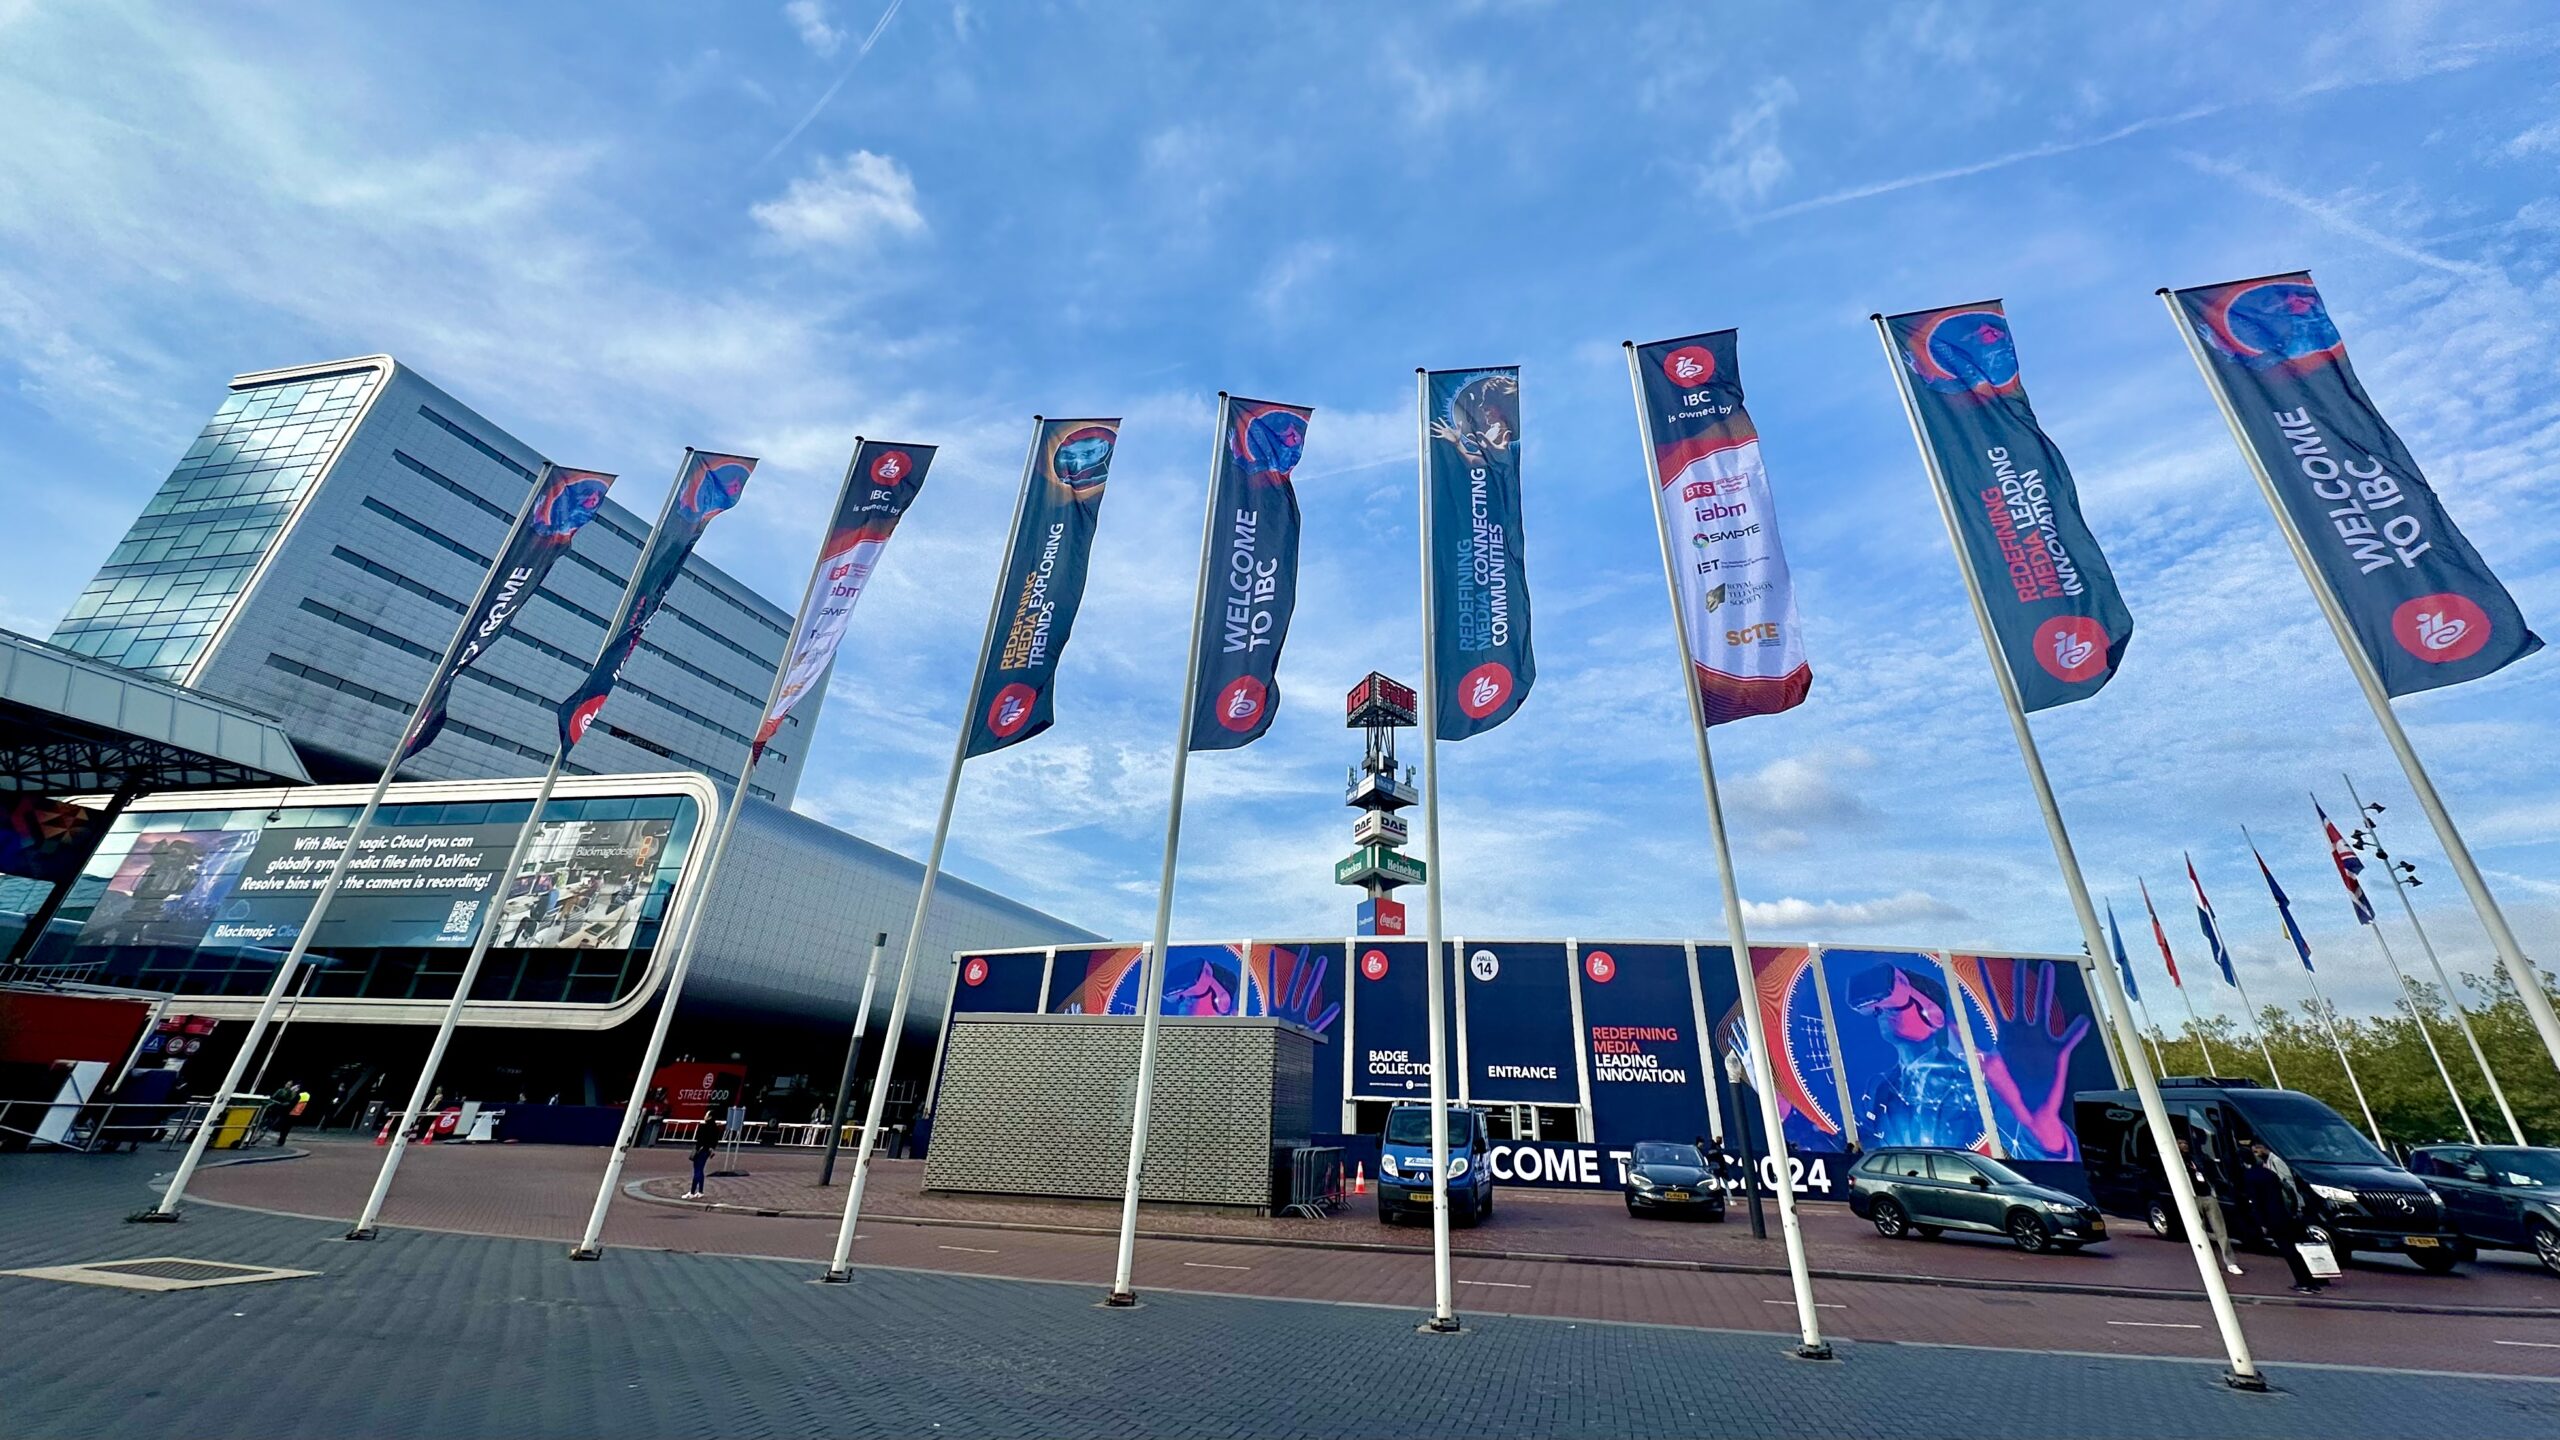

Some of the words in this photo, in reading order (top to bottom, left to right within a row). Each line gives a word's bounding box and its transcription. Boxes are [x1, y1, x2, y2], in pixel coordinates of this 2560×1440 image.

[1683, 391, 1711, 407] IBC
[1668, 415, 1676, 424] is
[1678, 405, 1716, 419] owned
[1719, 404, 1732, 414] by
[870, 489, 892, 501] IBC
[1685, 484, 1713, 498] BTS
[1987, 446, 2038, 530] LEADING
[2273, 406, 2395, 575] WELCOME
[2344, 454, 2405, 520] IBC
[853, 504, 860, 512] is
[861, 504, 889, 512] owned
[890, 506, 901, 516] by
[1694, 503, 1747, 522] iabm
[1471, 468, 1489, 586] CONNECTING
[1710, 523, 1760, 543] SMPTE
[2020, 468, 2084, 596] INNOVATION
[1981, 485, 2041, 603] REDEFINING
[2383, 515, 2433, 569] TO
[1697, 559, 1720, 575] IET
[2022, 529, 2065, 599] MEDIA
[1223, 509, 1257, 653] WELCOME
[1254, 557, 1278, 604] IBC
[1488, 524, 1509, 647] COMMUNITIES
[1727, 581, 1752, 590] ROYAL
[1728, 583, 1773, 598] TELEVISION
[1014, 612, 1039, 669] MEDIA
[1028, 523, 1064, 609] EXPLORING
[1457, 538, 1475, 651] REDEFINING
[1729, 594, 1761, 606] SOCIETY
[1000, 570, 1037, 671] REDEFINING
[1475, 590, 1492, 651] MEDIA
[1028, 601, 1055, 669] TRENDS
[1249, 610, 1273, 652] TO
[1726, 622, 1779, 646] SCTE
[1354, 817, 1372, 833] DAF
[1381, 817, 1407, 831] DAF
[294, 836, 320, 850] With
[390, 834, 428, 848] Cloud
[424, 838, 450, 852] you
[450, 837, 474, 848] can
[265, 855, 315, 874] globally
[381, 854, 408, 869] files
[408, 854, 433, 868] into
[433, 852, 483, 868] DaVinci
[1387, 859, 1422, 879] Heineken
[240, 876, 285, 891] Resolve
[284, 875, 311, 890] bins
[343, 875, 364, 889] the
[365, 878, 413, 889] camera
[413, 874, 425, 888] is
[425, 872, 493, 892] recording!
[214, 924, 277, 941] Blackmagic
[1477, 963, 1493, 976] 14
[1592, 1026, 1678, 1041] REDEFINING
[1369, 1050, 1409, 1062] BADGE
[1594, 1041, 1641, 1054] MEDIA
[1369, 1062, 1431, 1075] COLLECTIO
[1595, 1054, 1658, 1068] LEADING
[1488, 1065, 1557, 1079] ENTRANCE
[1597, 1068, 1686, 1084] INNOVATION
[677, 1089, 730, 1100] STREETFOOD
